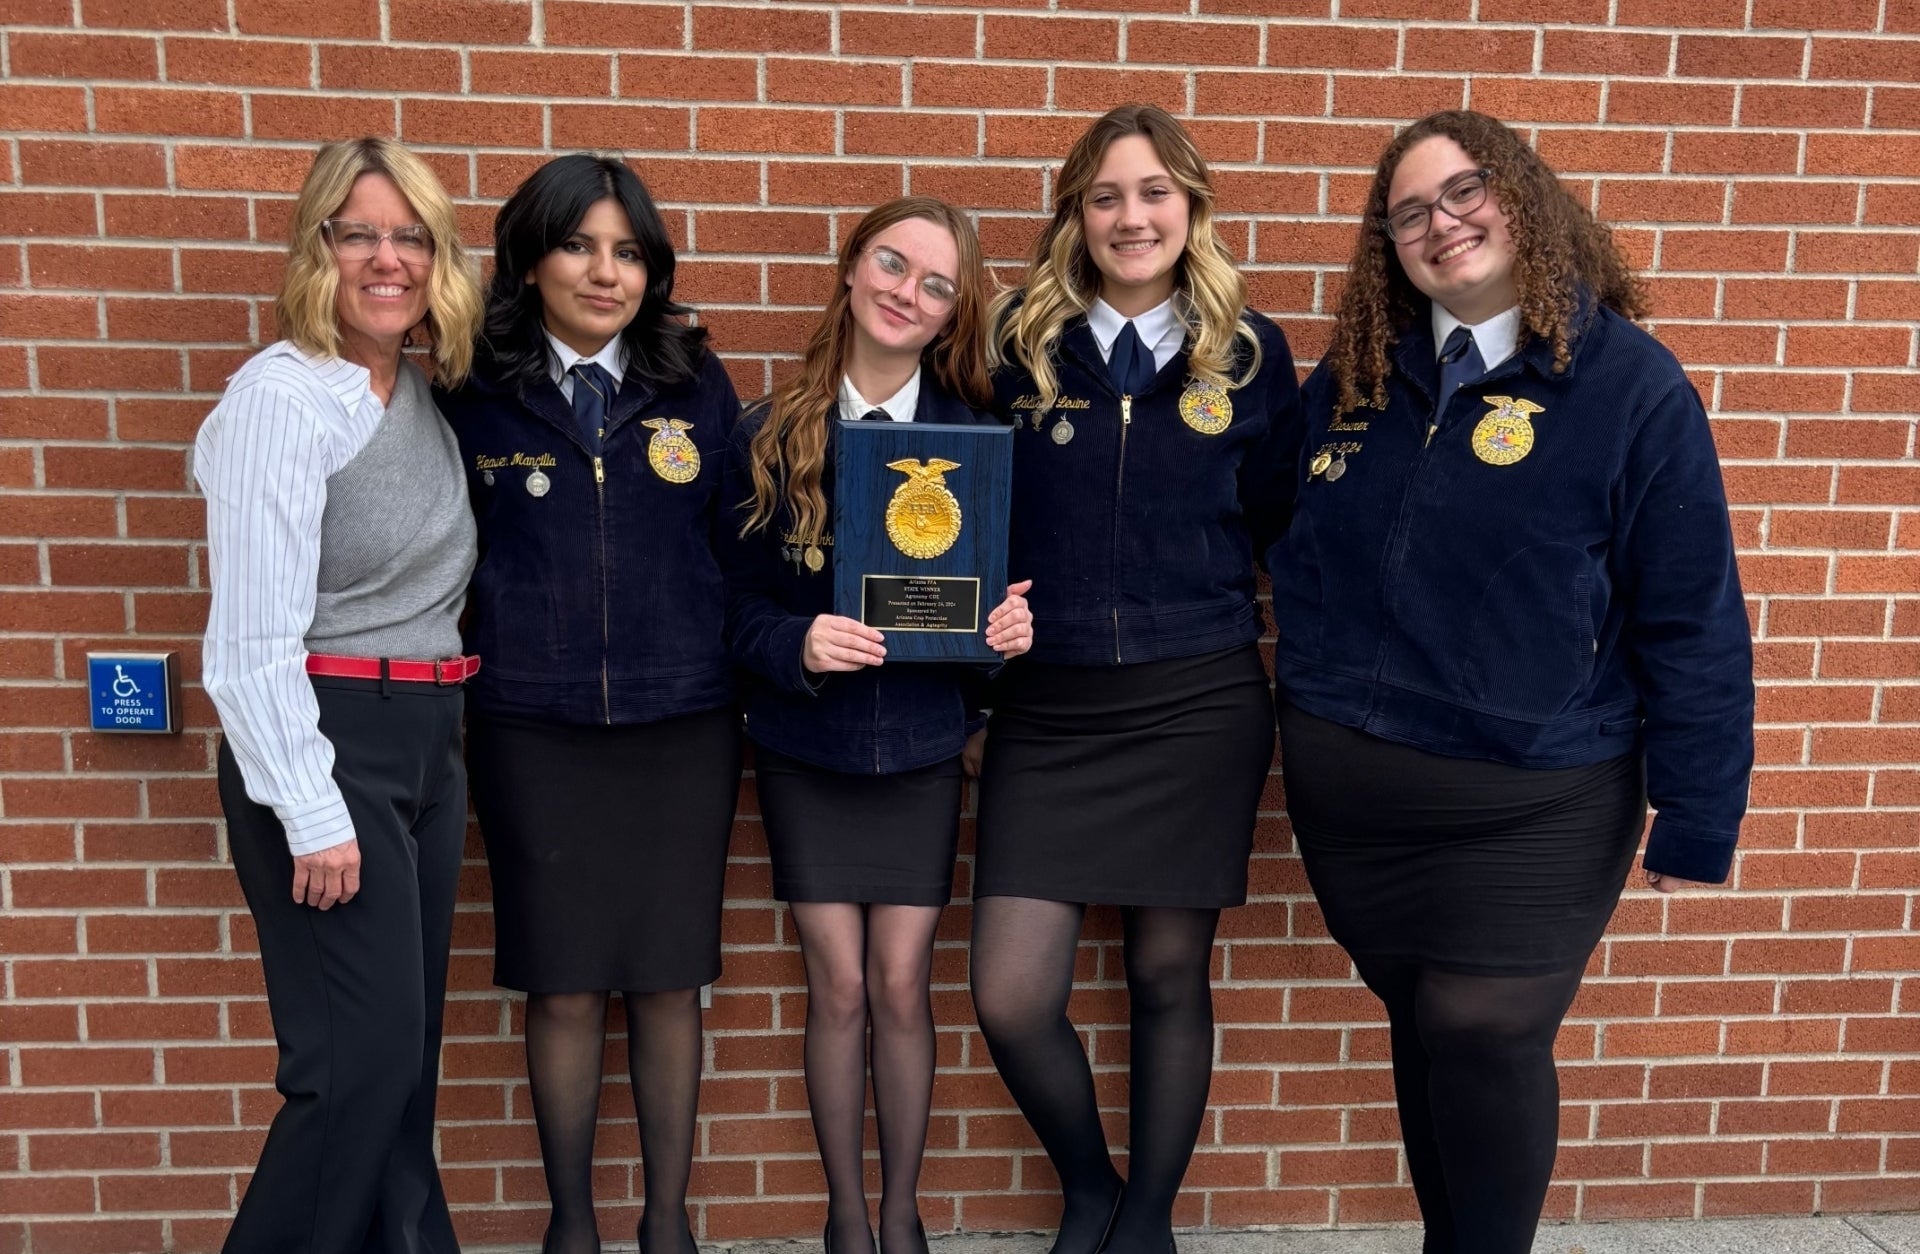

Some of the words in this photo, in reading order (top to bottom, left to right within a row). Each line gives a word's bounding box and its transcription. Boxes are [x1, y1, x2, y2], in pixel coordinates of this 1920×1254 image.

[1497, 425, 1515, 435] FFA
[510, 452, 557, 467] Mancilla
[909, 502, 937, 515] FFA
